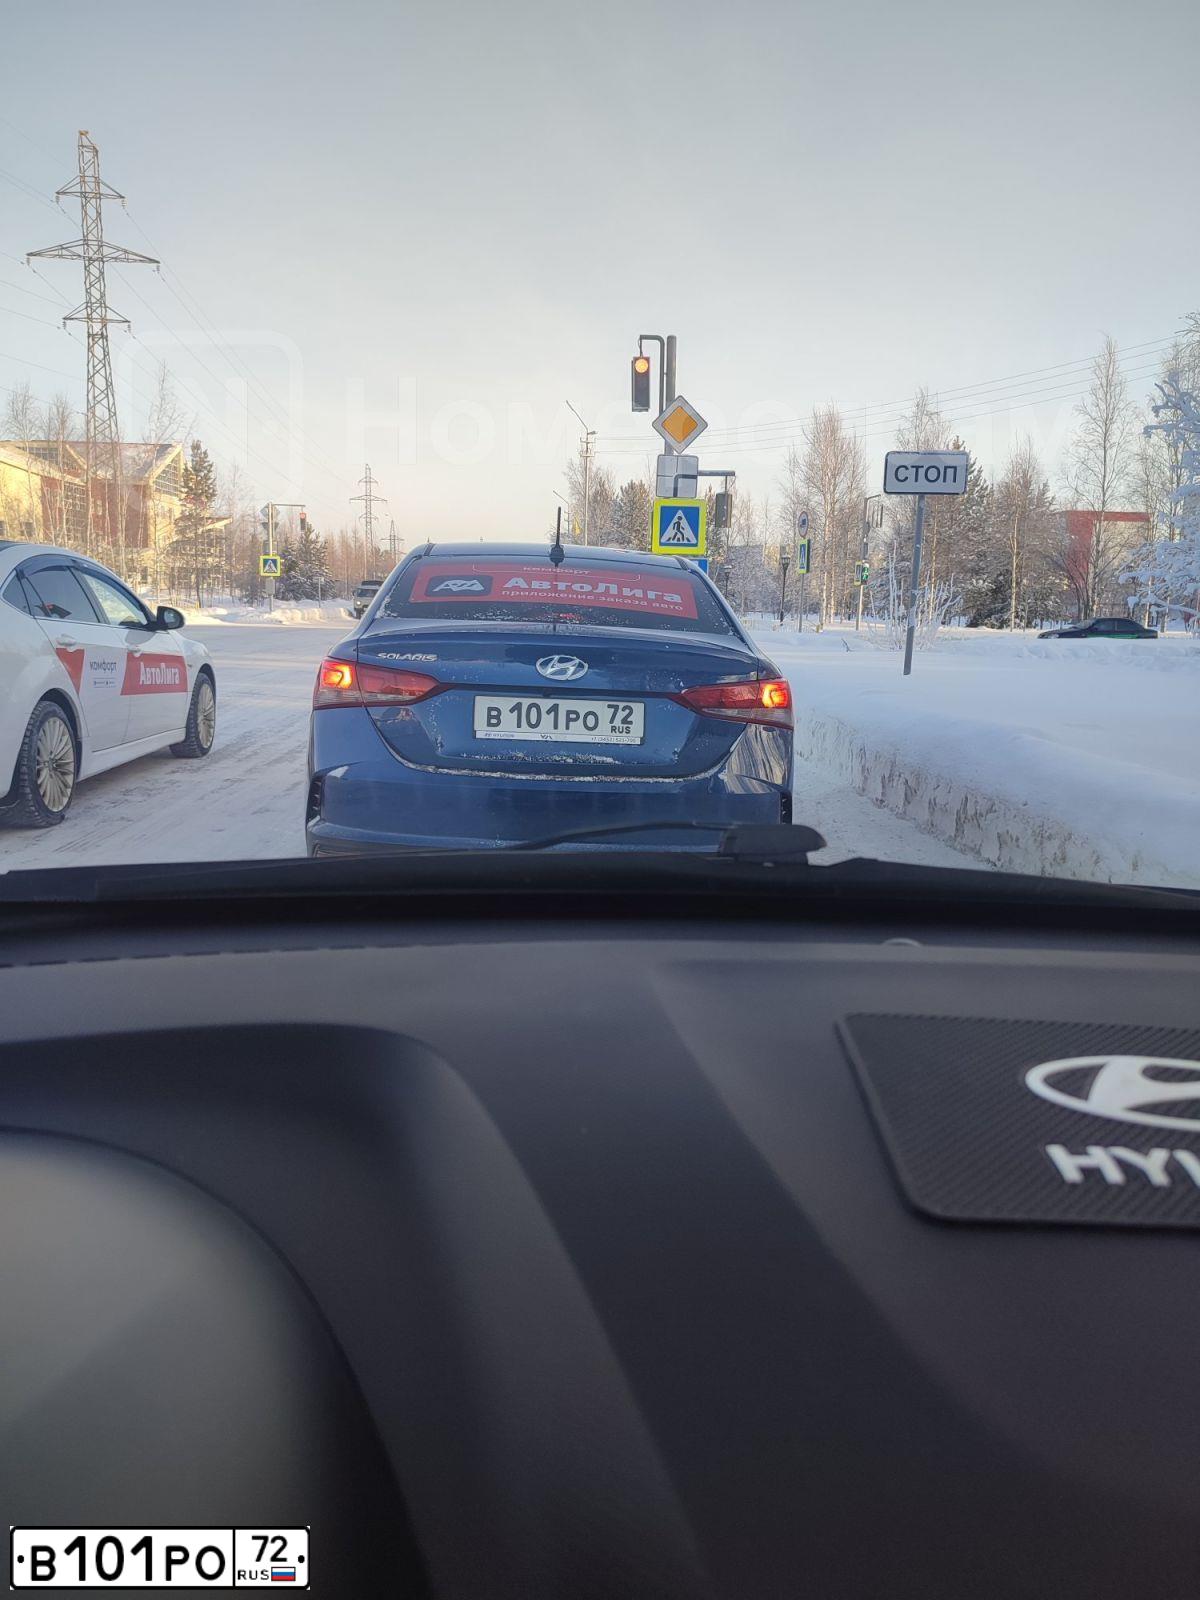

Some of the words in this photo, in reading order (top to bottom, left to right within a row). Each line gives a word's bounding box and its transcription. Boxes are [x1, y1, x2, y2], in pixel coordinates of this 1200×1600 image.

[894, 465, 958, 483] СТОП
[503, 577, 682, 602] АвтоЛига
[502, 590, 595, 600] приложение
[652, 603, 684, 611] авто
[89, 659, 117, 674] комфорт
[376, 652, 438, 662] SOLARIS
[139, 661, 180, 685] АвтоЛига
[607, 704, 634, 725] 72
[610, 725, 631, 734] RUS
